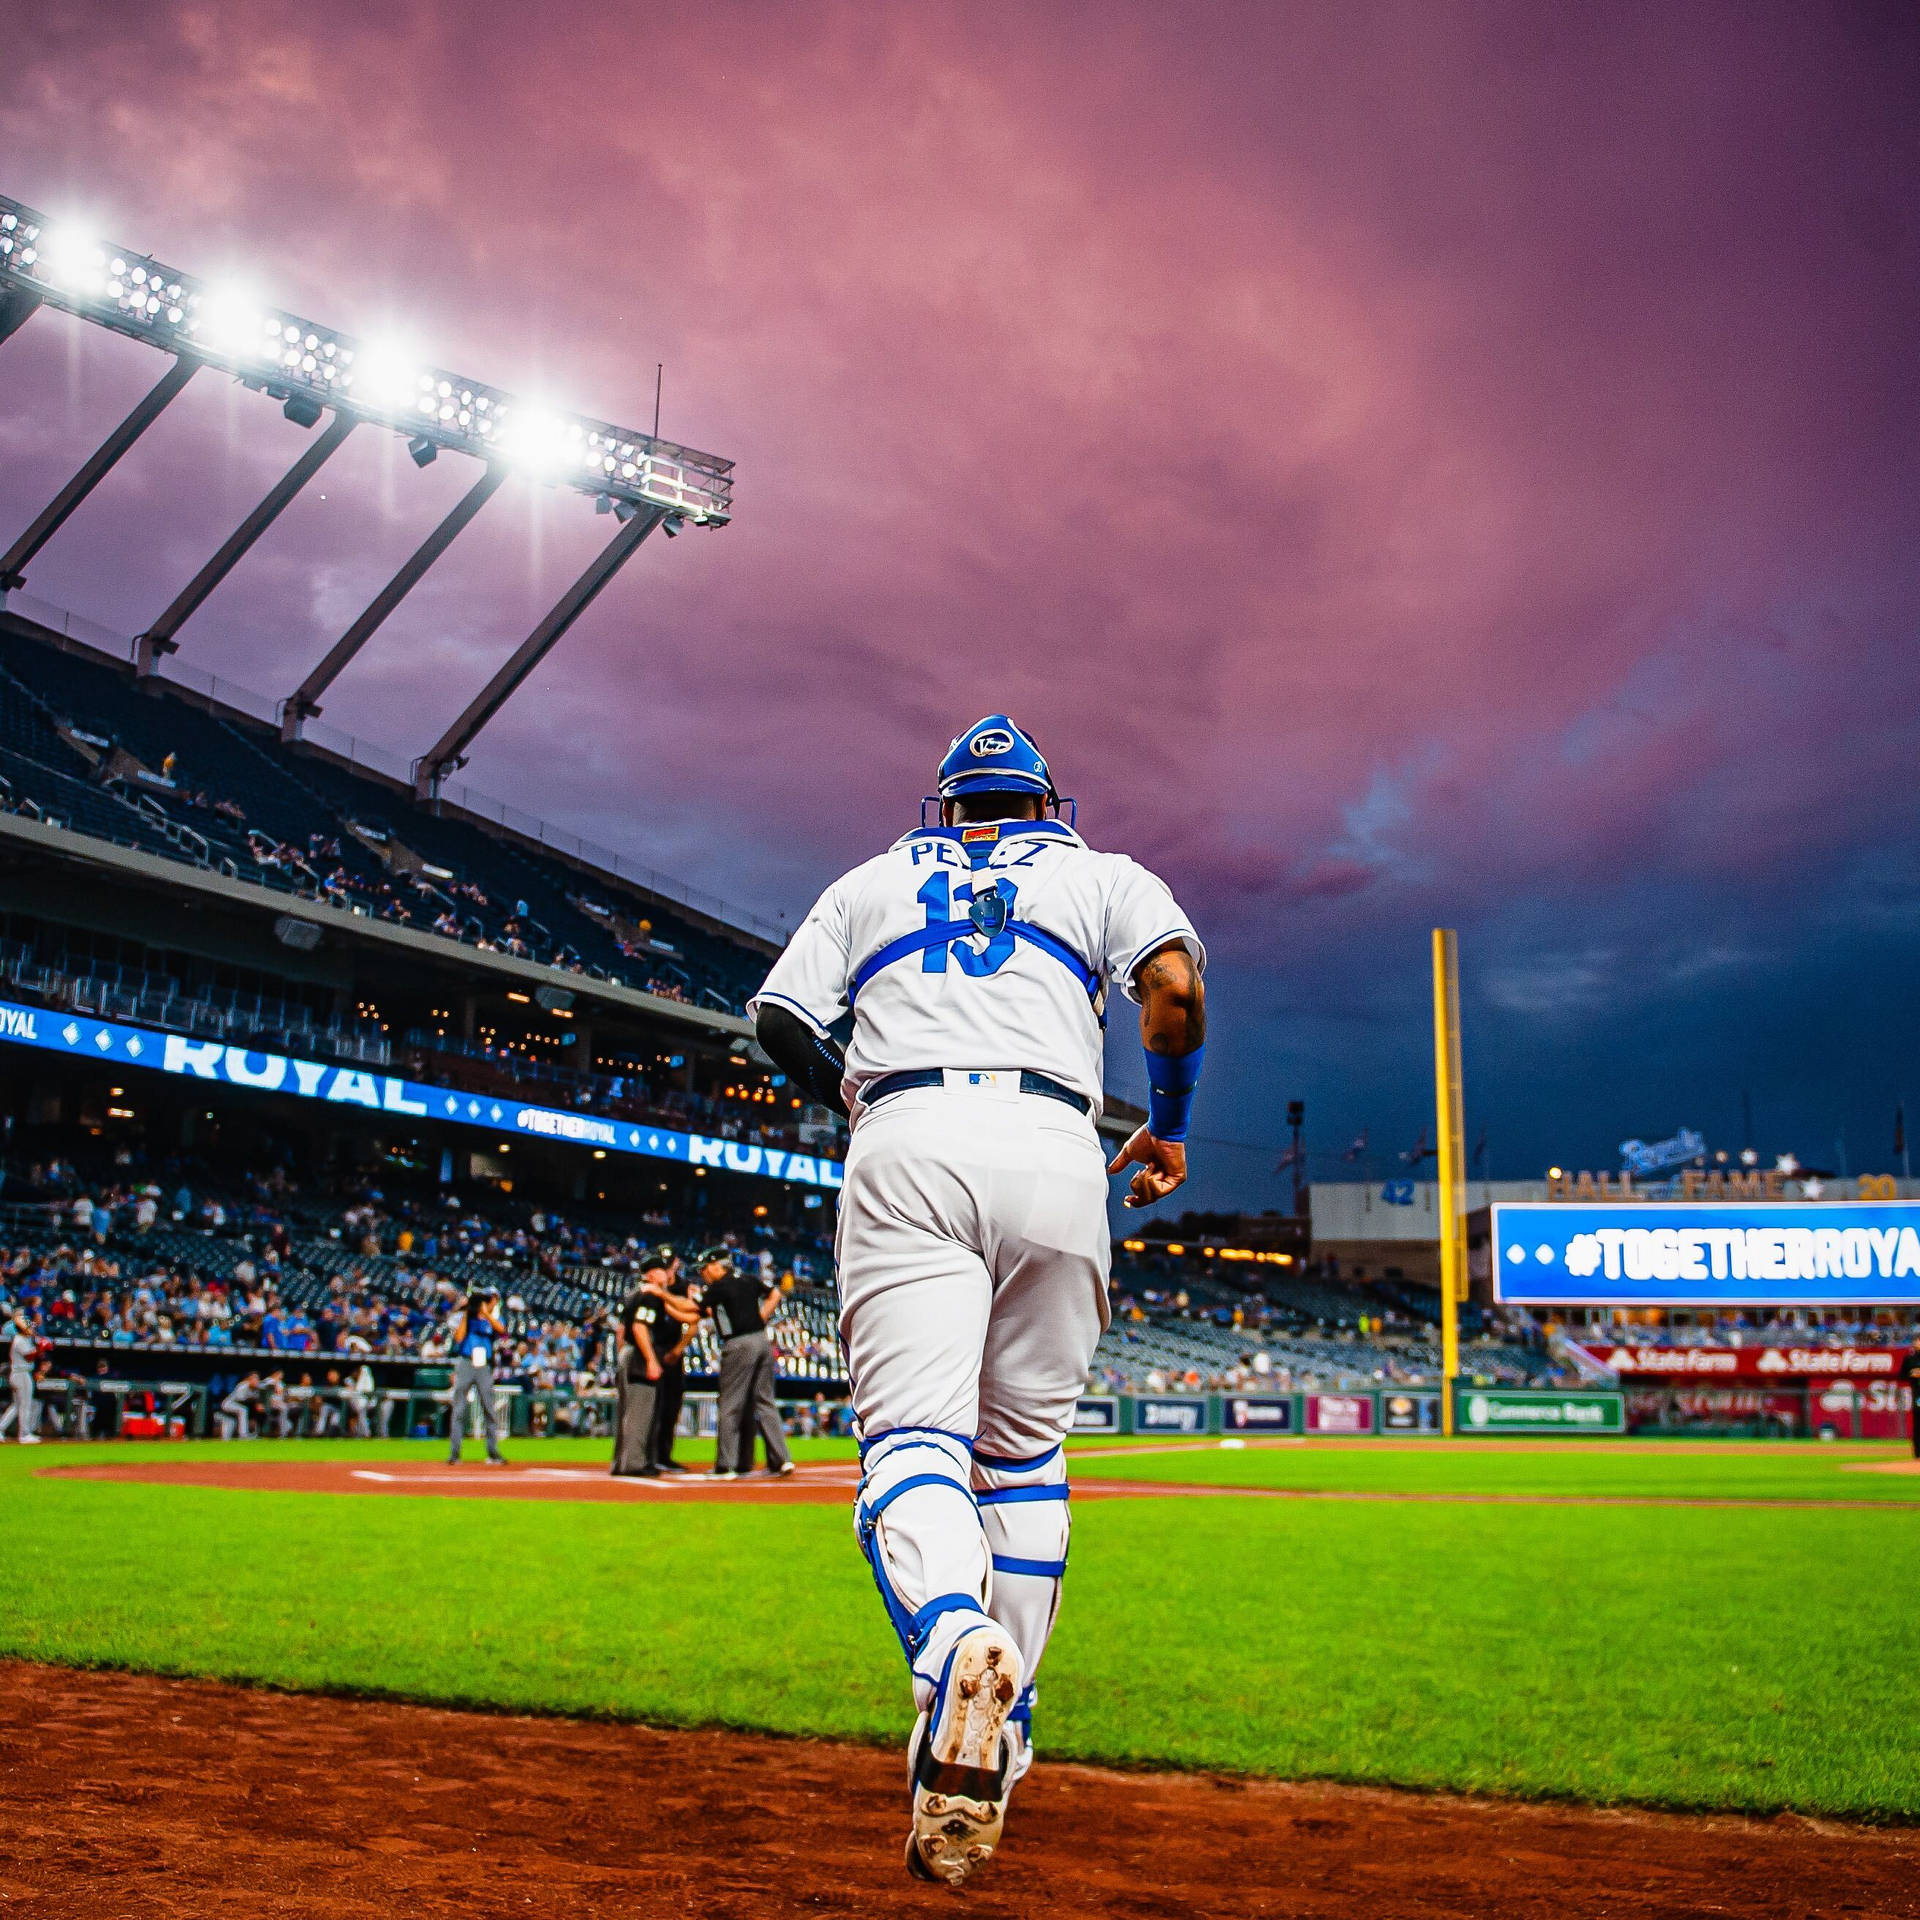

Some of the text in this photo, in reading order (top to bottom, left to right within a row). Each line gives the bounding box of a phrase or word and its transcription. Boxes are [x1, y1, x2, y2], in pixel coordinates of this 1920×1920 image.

[917, 871, 1018, 977] 13
[163, 1033, 428, 1117] ROYAL
[688, 1134, 843, 1188] ROYAL
[1548, 1170, 1639, 1200] HALL
[1682, 1169, 1787, 1200] FAME
[1564, 1226, 1920, 1281] #TOGETHERROYA
[1637, 1349, 1738, 1372] State Farm
[1788, 1349, 1893, 1372] State Farm
